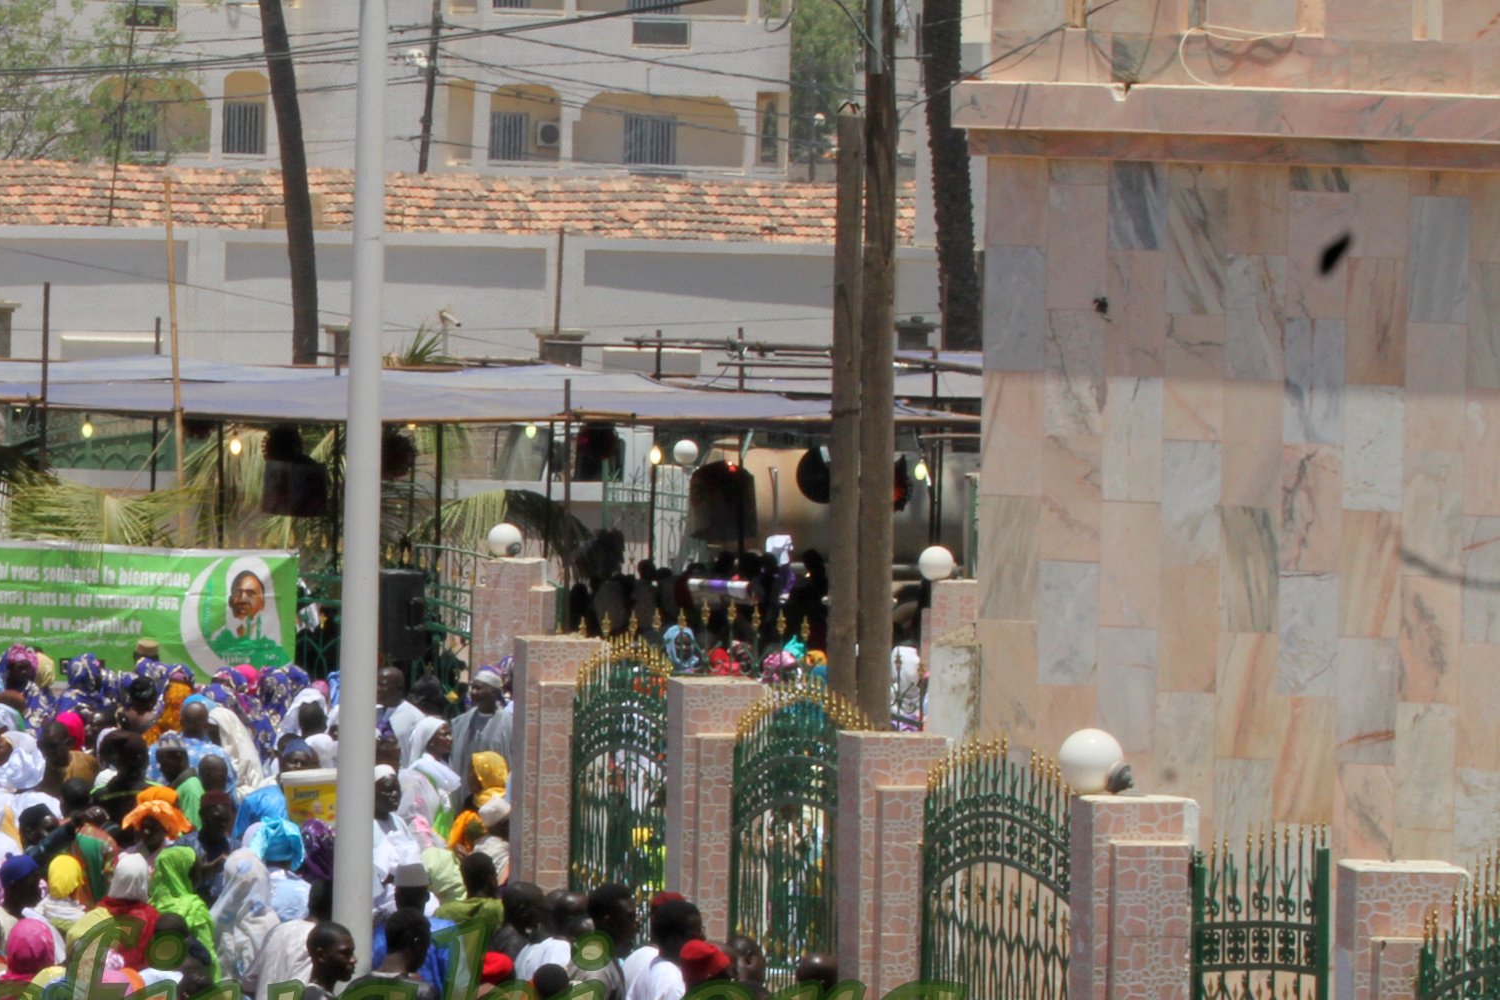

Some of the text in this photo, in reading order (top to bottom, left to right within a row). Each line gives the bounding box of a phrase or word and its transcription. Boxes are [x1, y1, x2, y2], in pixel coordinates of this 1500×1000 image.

[11, 565, 40, 581] vous
[43, 564, 99, 584] souhaite
[102, 565, 116, 585] la
[118, 566, 190, 588] bienvenue
[26, 590, 57, 606] FORTS
[156, 595, 179, 611] SUR
[42, 616, 143, 637] www.asfiyahi.tv
